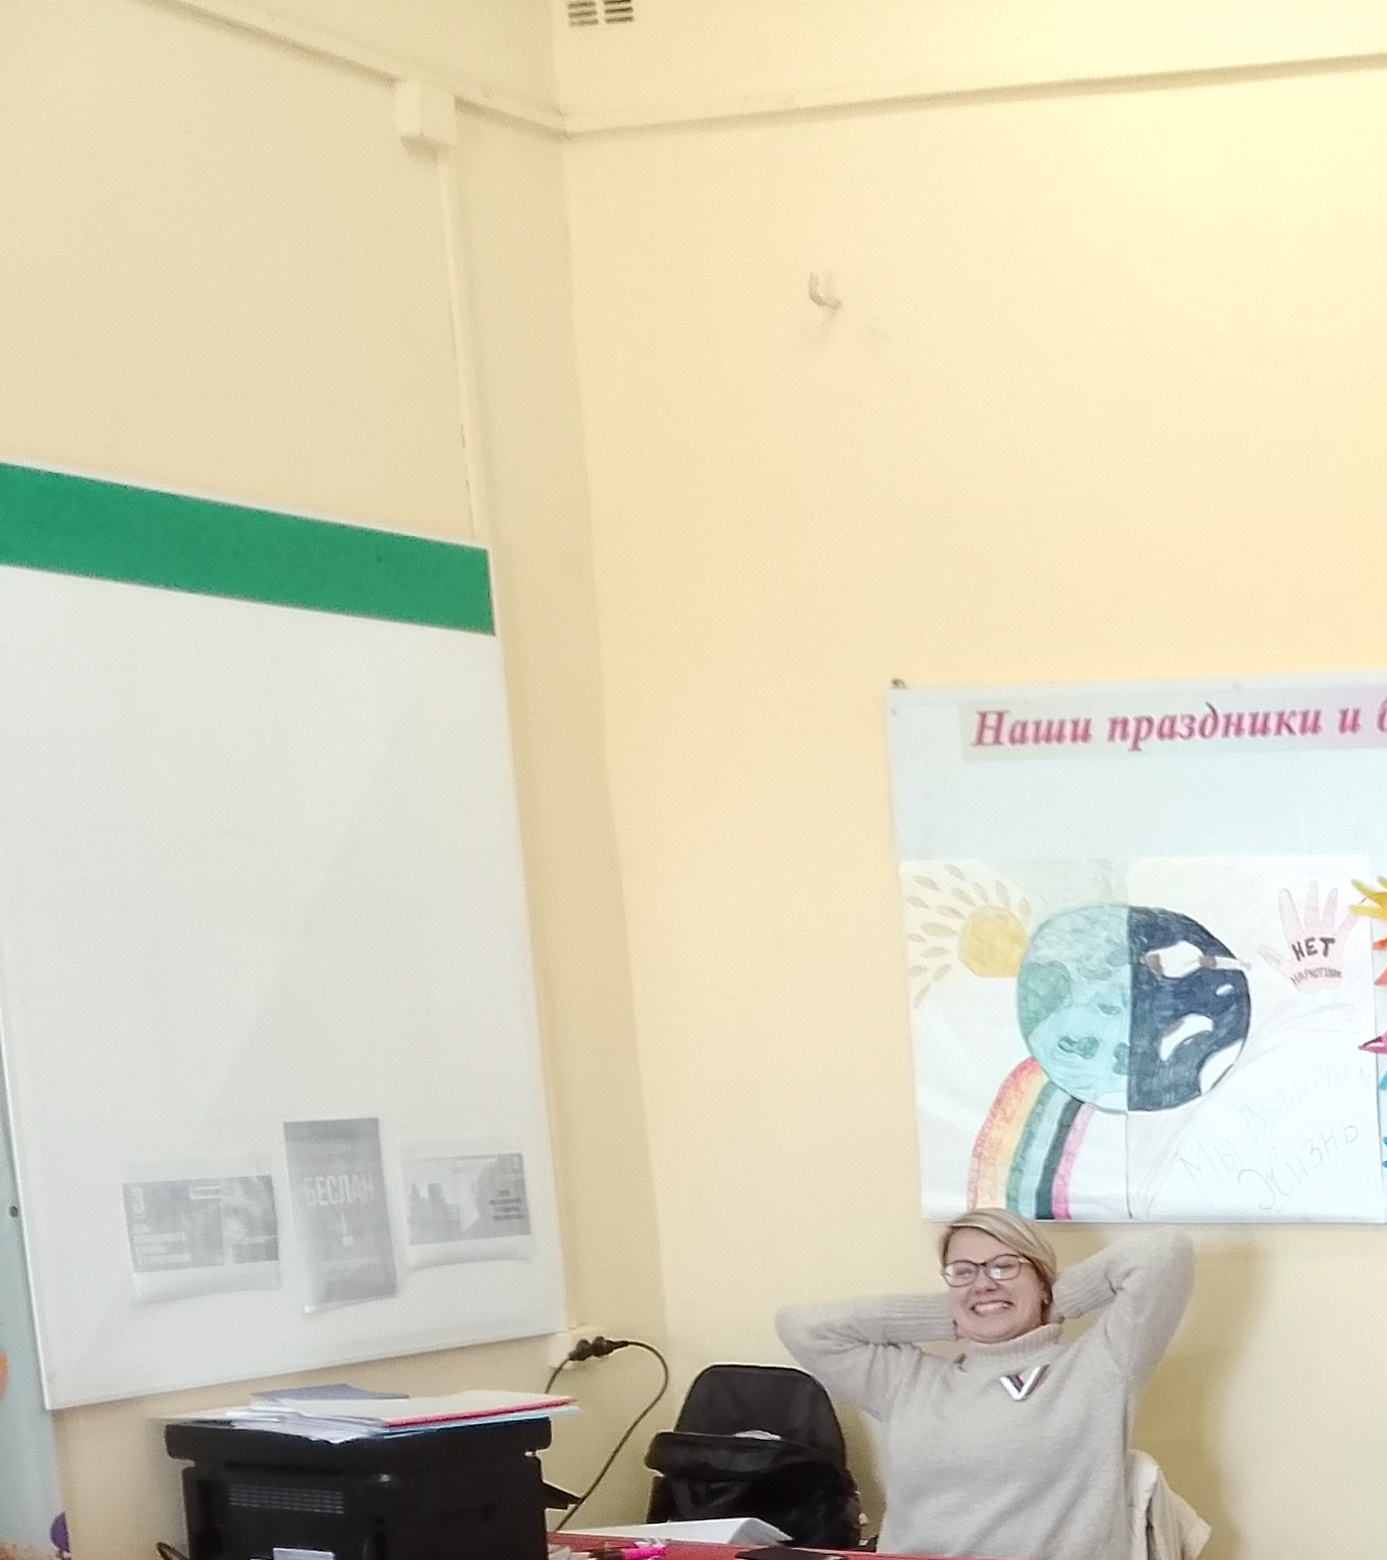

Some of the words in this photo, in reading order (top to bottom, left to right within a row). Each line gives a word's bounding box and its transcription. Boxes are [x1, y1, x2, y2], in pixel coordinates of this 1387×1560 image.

[971, 710, 1092, 747] Наши
[1106, 702, 1322, 752] праздники
[1338, 707, 1361, 734] и
[1291, 937, 1336, 962] НЕТ
[304, 1173, 376, 1206] БЕСЛАН
